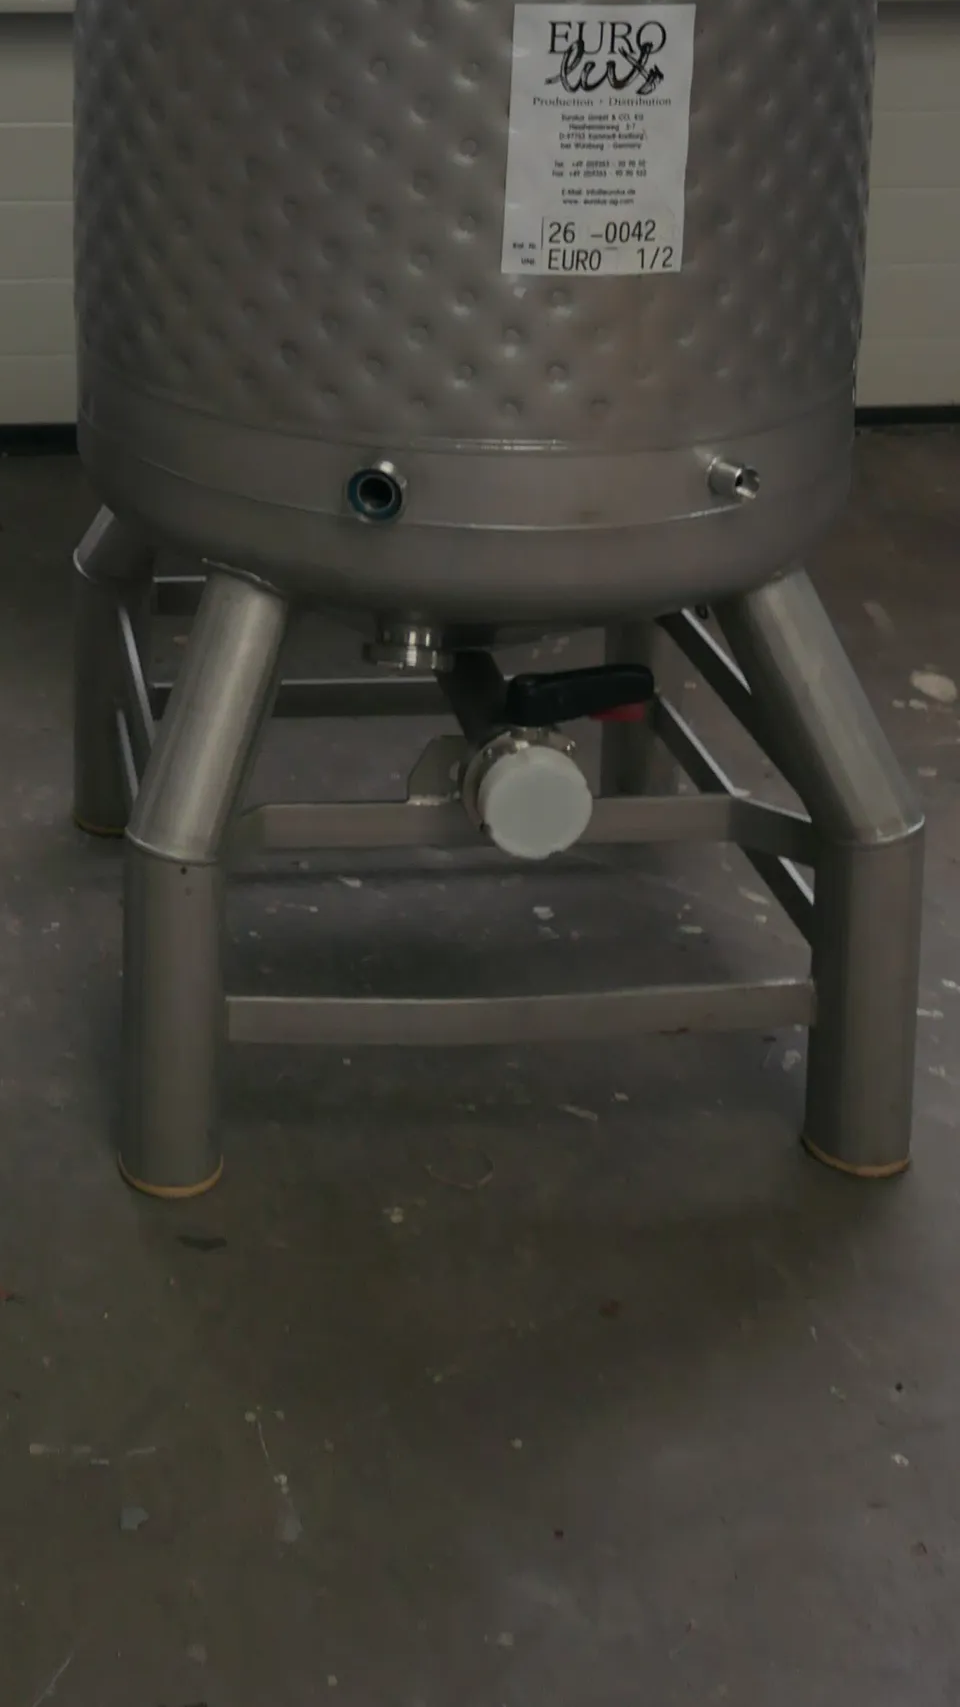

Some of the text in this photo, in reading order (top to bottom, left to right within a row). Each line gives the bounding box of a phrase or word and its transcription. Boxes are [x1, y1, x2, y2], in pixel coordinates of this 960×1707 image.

[548, 20, 667, 55] EURO
[532, 96, 593, 107] Production
[608, 96, 672, 107] Distribution
[548, 219, 656, 244] 26 -0042
[547, 246, 673, 271] EURO 1/2
